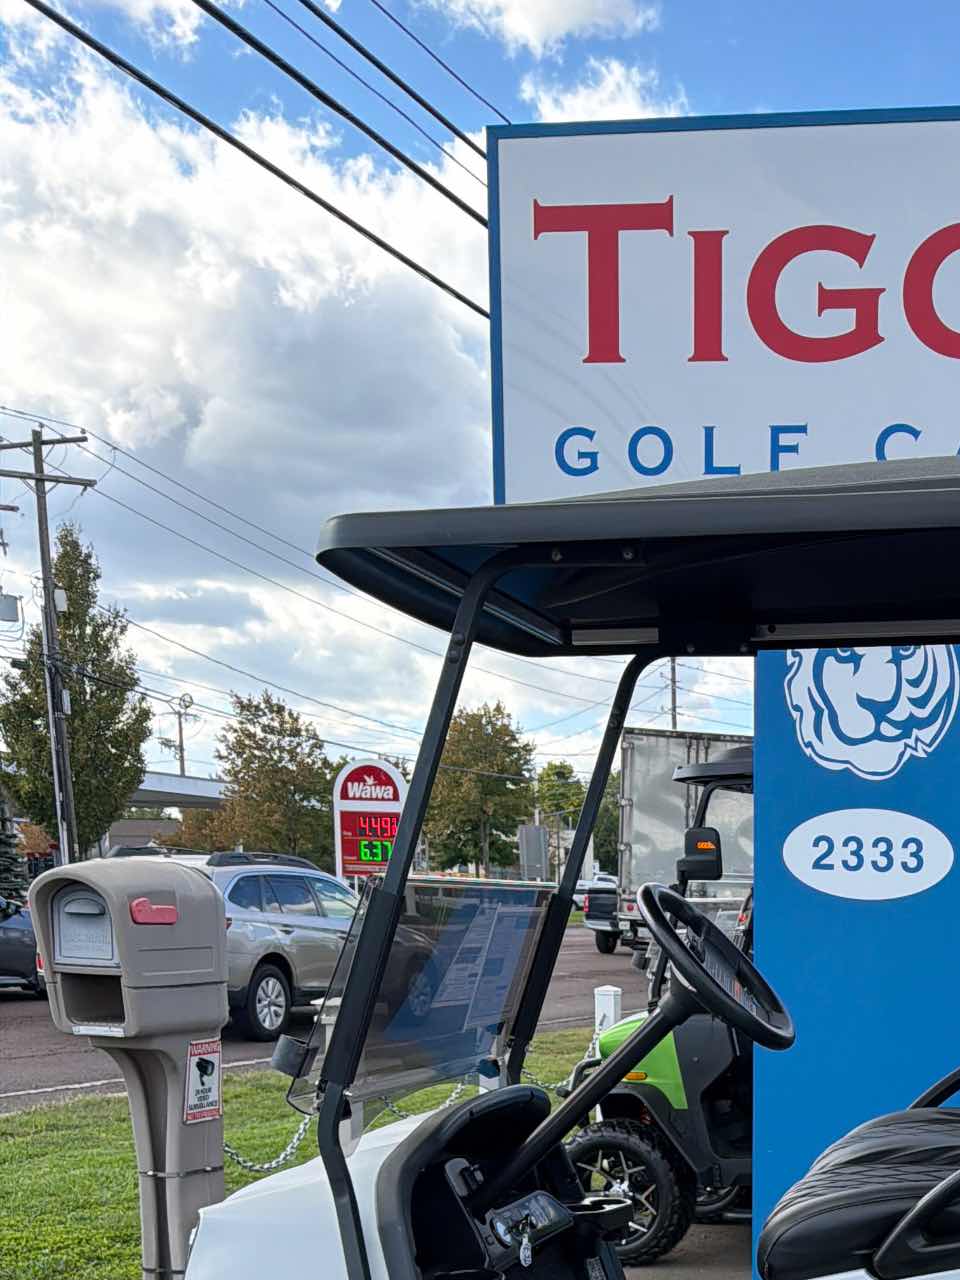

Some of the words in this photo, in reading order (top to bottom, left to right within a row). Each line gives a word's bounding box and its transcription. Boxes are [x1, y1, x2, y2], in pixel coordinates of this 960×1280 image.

[554, 422, 808, 477] GOLF
[347, 782, 394, 799] Wawa
[811, 835, 925, 873] 2333
